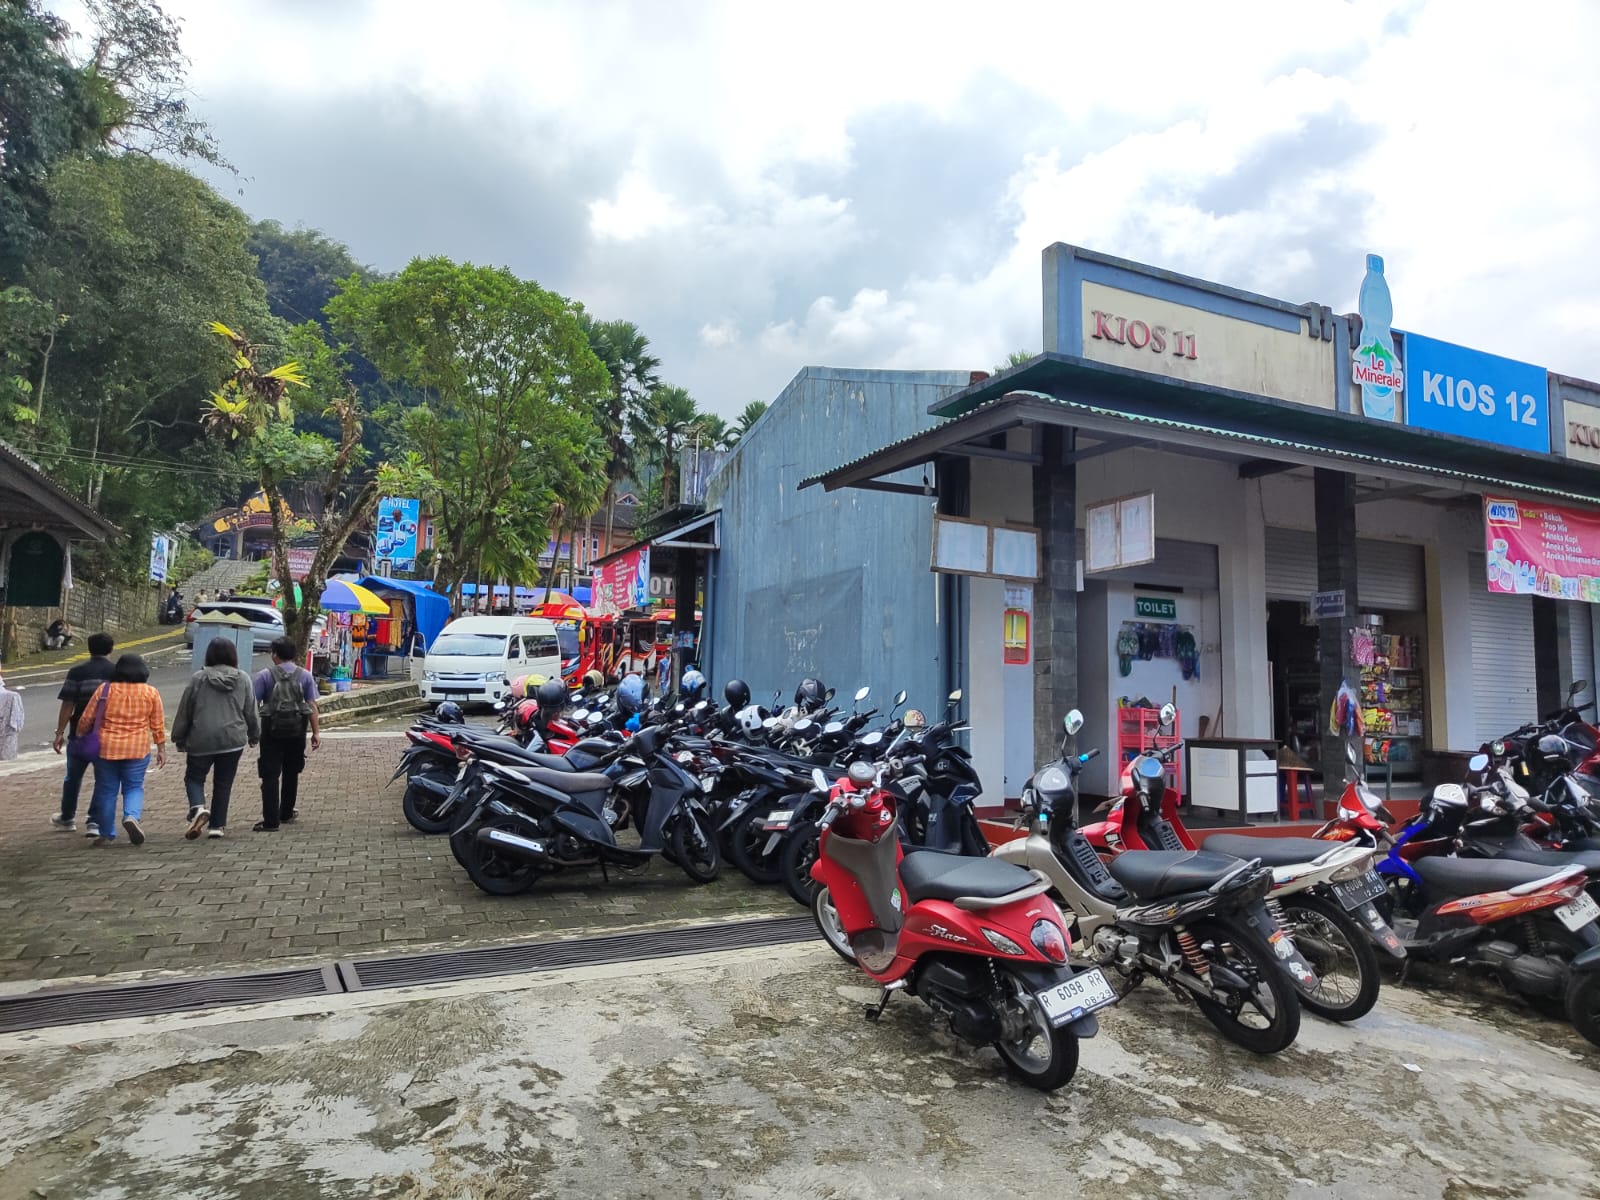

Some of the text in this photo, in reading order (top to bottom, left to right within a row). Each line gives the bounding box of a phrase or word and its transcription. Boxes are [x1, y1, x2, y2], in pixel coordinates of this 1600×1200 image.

[1091, 310, 1197, 360] KIOS 11
[1371, 354, 1385, 371] Le
[1356, 365, 1401, 388] Minerale
[1422, 369, 1537, 426] KIOS 12
[1507, 507, 1516, 518] 12
[1544, 522, 1557, 532] Pop
[1545, 532, 1578, 545] Aneka Kopi
[1546, 542, 1582, 554] Aneka Snack
[1546, 551, 1564, 561] Aneka
[1565, 554, 1591, 565] Minuman
[1136, 601, 1175, 615] TOILET
[1041, 972, 1104, 1008] R 6098 RR
